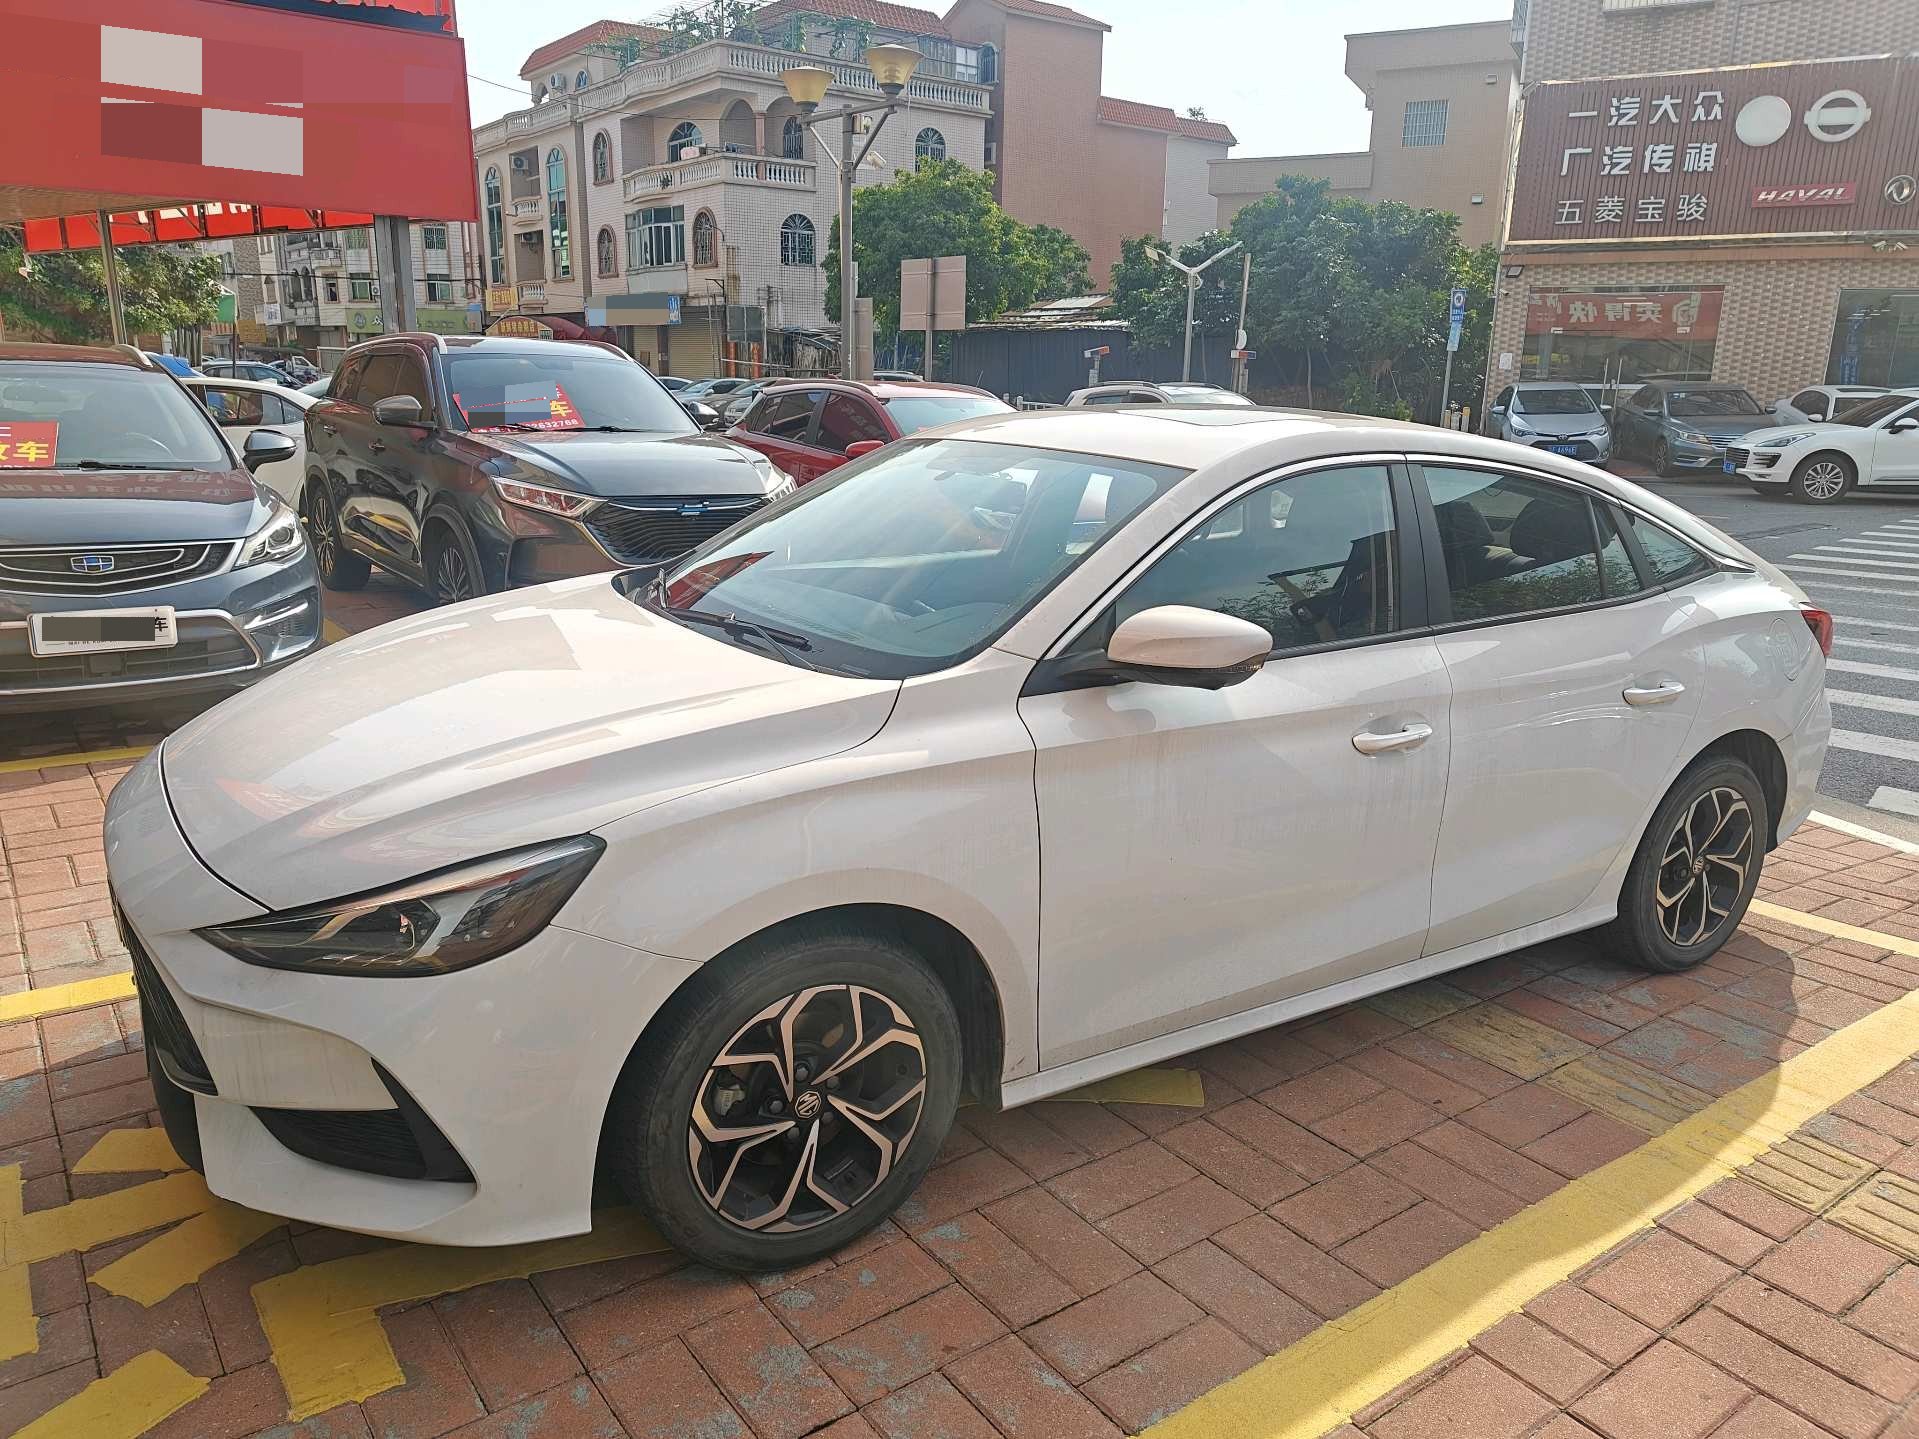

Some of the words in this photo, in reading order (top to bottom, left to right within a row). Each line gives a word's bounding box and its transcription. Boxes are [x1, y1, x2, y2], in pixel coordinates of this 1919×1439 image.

[1568, 90, 1725, 126] 一汽大众
[1560, 142, 1718, 176] 广汽传祺
[1555, 193, 1708, 225] 五菱宝骏
[1757, 187, 1847, 202] HAVAL
